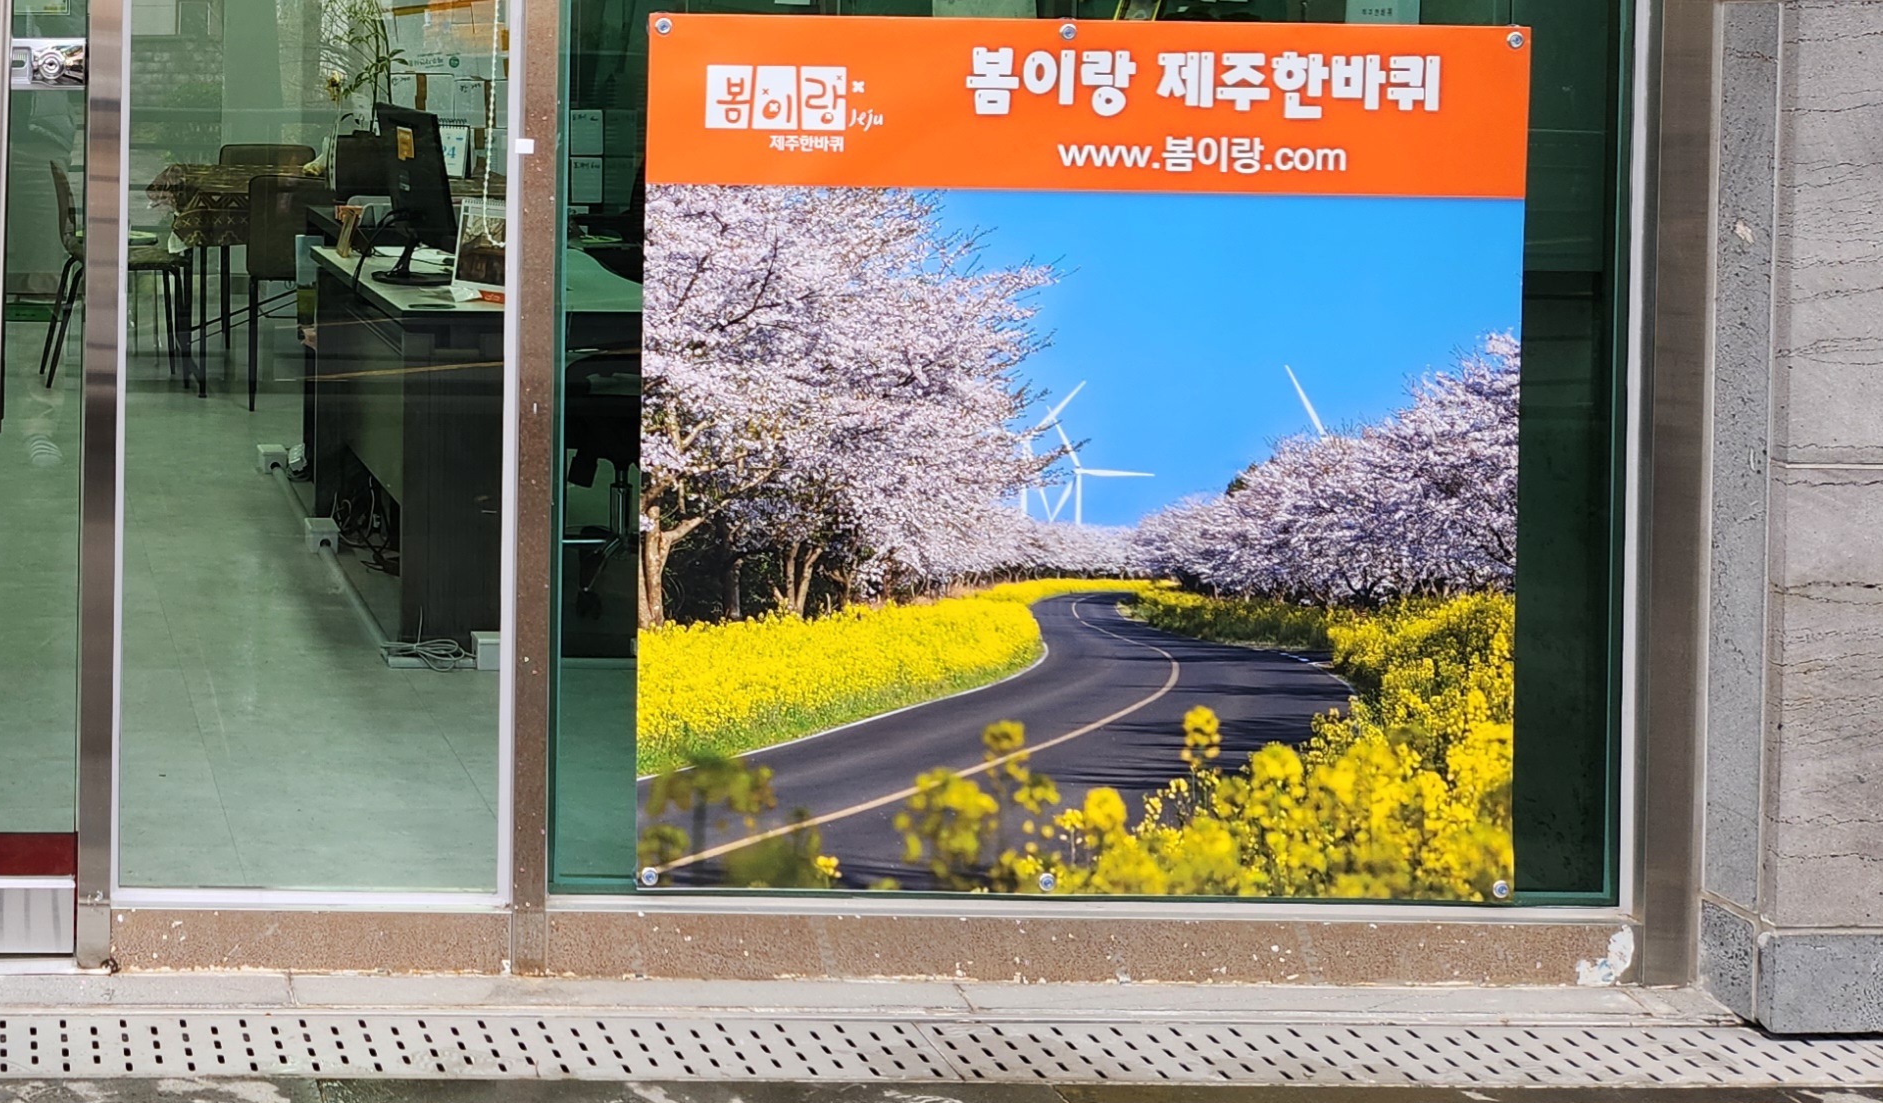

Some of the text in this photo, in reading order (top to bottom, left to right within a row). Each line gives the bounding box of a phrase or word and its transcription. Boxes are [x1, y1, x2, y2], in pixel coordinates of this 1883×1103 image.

[965, 47, 1441, 120] 봄이랑 제주한바퀴
[848, 105, 885, 129] Jeju
[768, 133, 845, 153] 제주한바퀴
[1056, 135, 1347, 174] www.봄이랑.com
